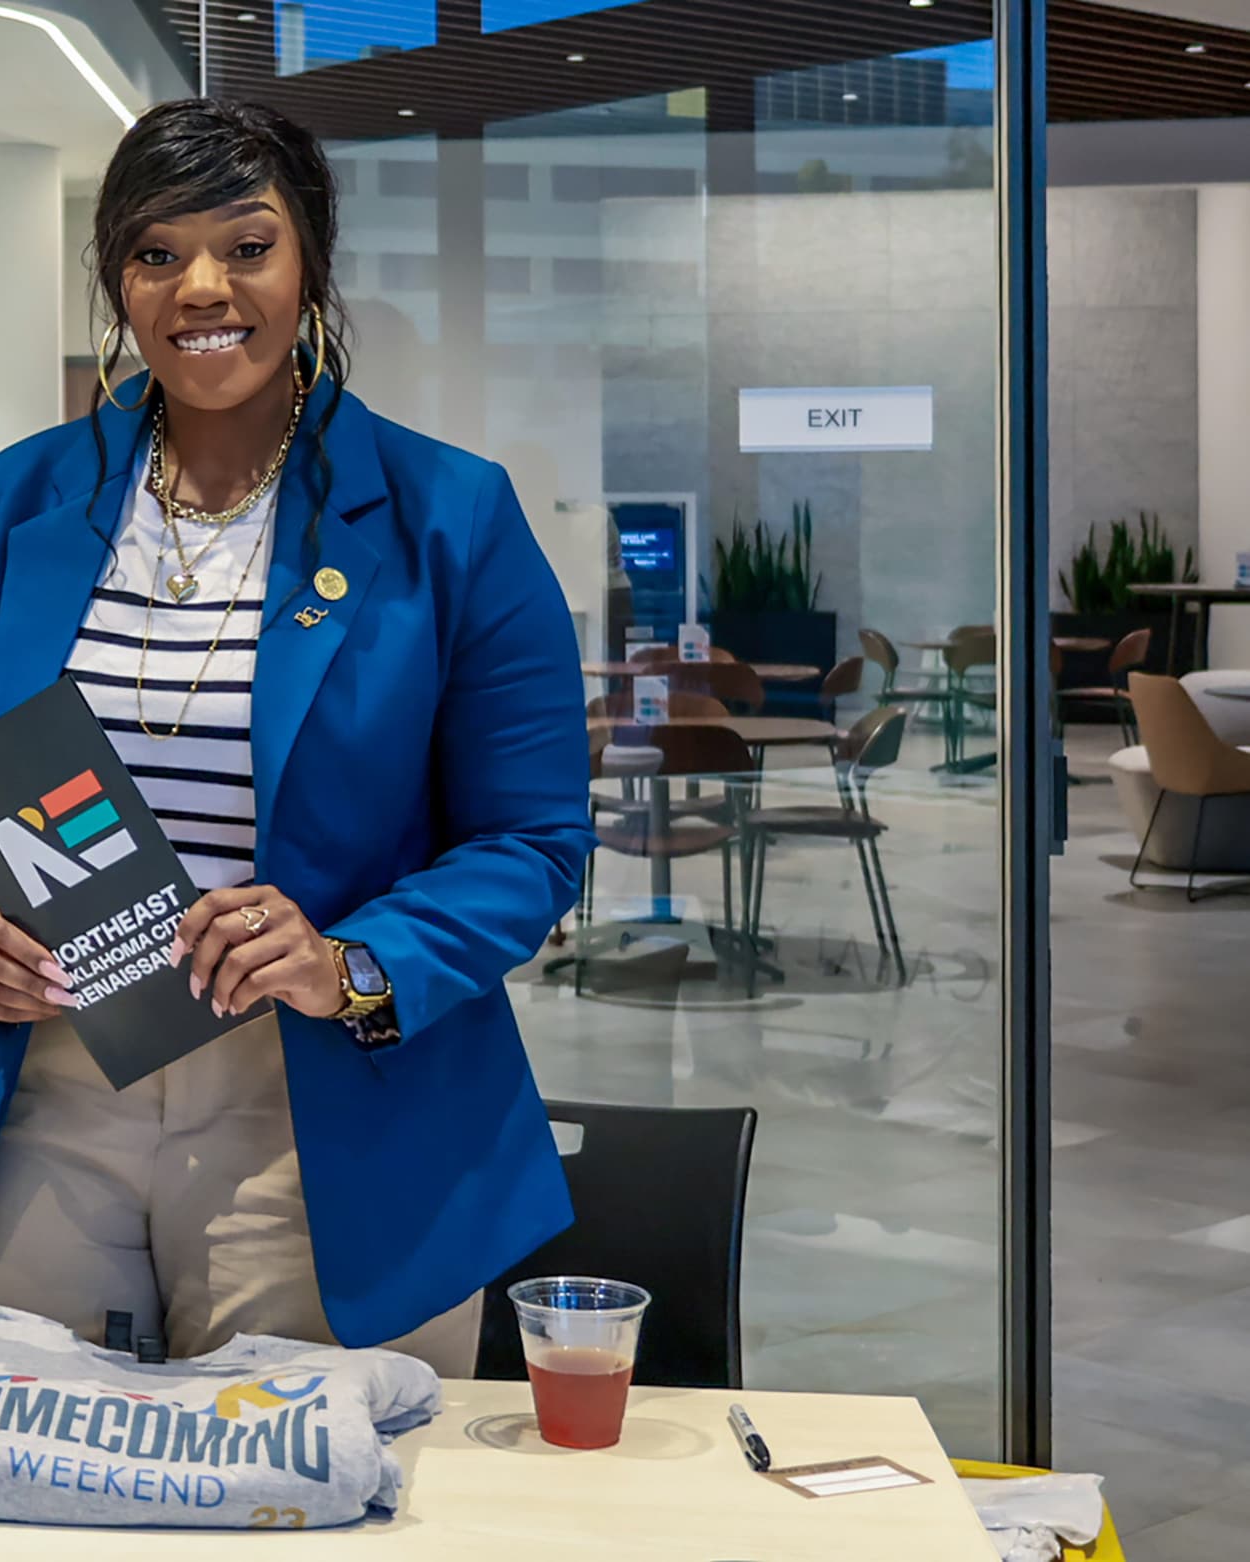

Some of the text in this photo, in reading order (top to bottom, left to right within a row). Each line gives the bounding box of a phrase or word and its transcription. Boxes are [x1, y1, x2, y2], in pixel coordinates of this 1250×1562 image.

[808, 409, 862, 428] EXIT
[68, 932, 154, 985] KLAHOMA
[73, 941, 175, 1012] RENAISSAN
[8, 1446, 225, 1508] WEEKEND
